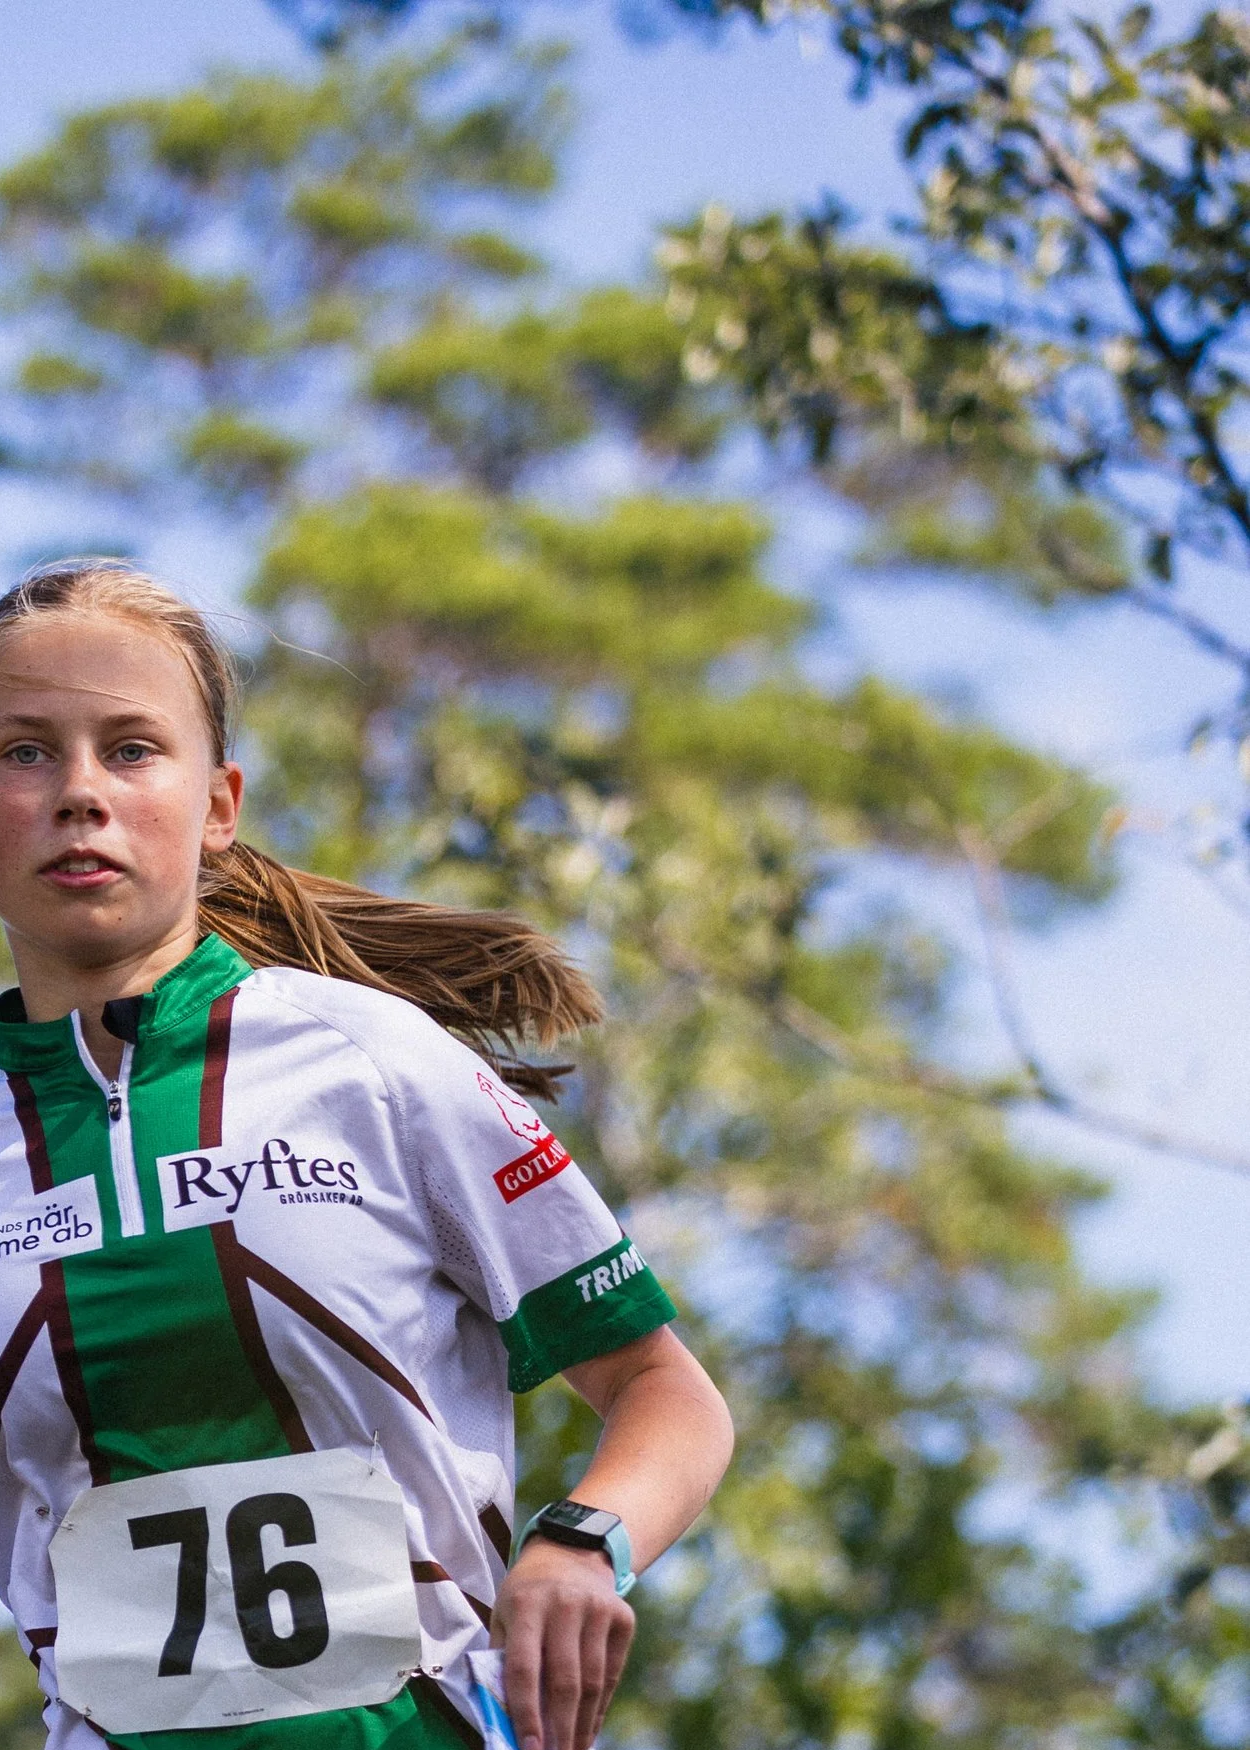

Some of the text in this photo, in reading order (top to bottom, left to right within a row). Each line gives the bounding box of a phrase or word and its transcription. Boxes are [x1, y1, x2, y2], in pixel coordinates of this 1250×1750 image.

[168, 1138, 360, 1214] Ryftes
[279, 1191, 364, 1206] GRÖNSAKER AB
[27, 1203, 74, 1233] när
[52, 1214, 93, 1243] ab
[575, 1243, 648, 1303] TRIM
[127, 1491, 330, 1678] 76
